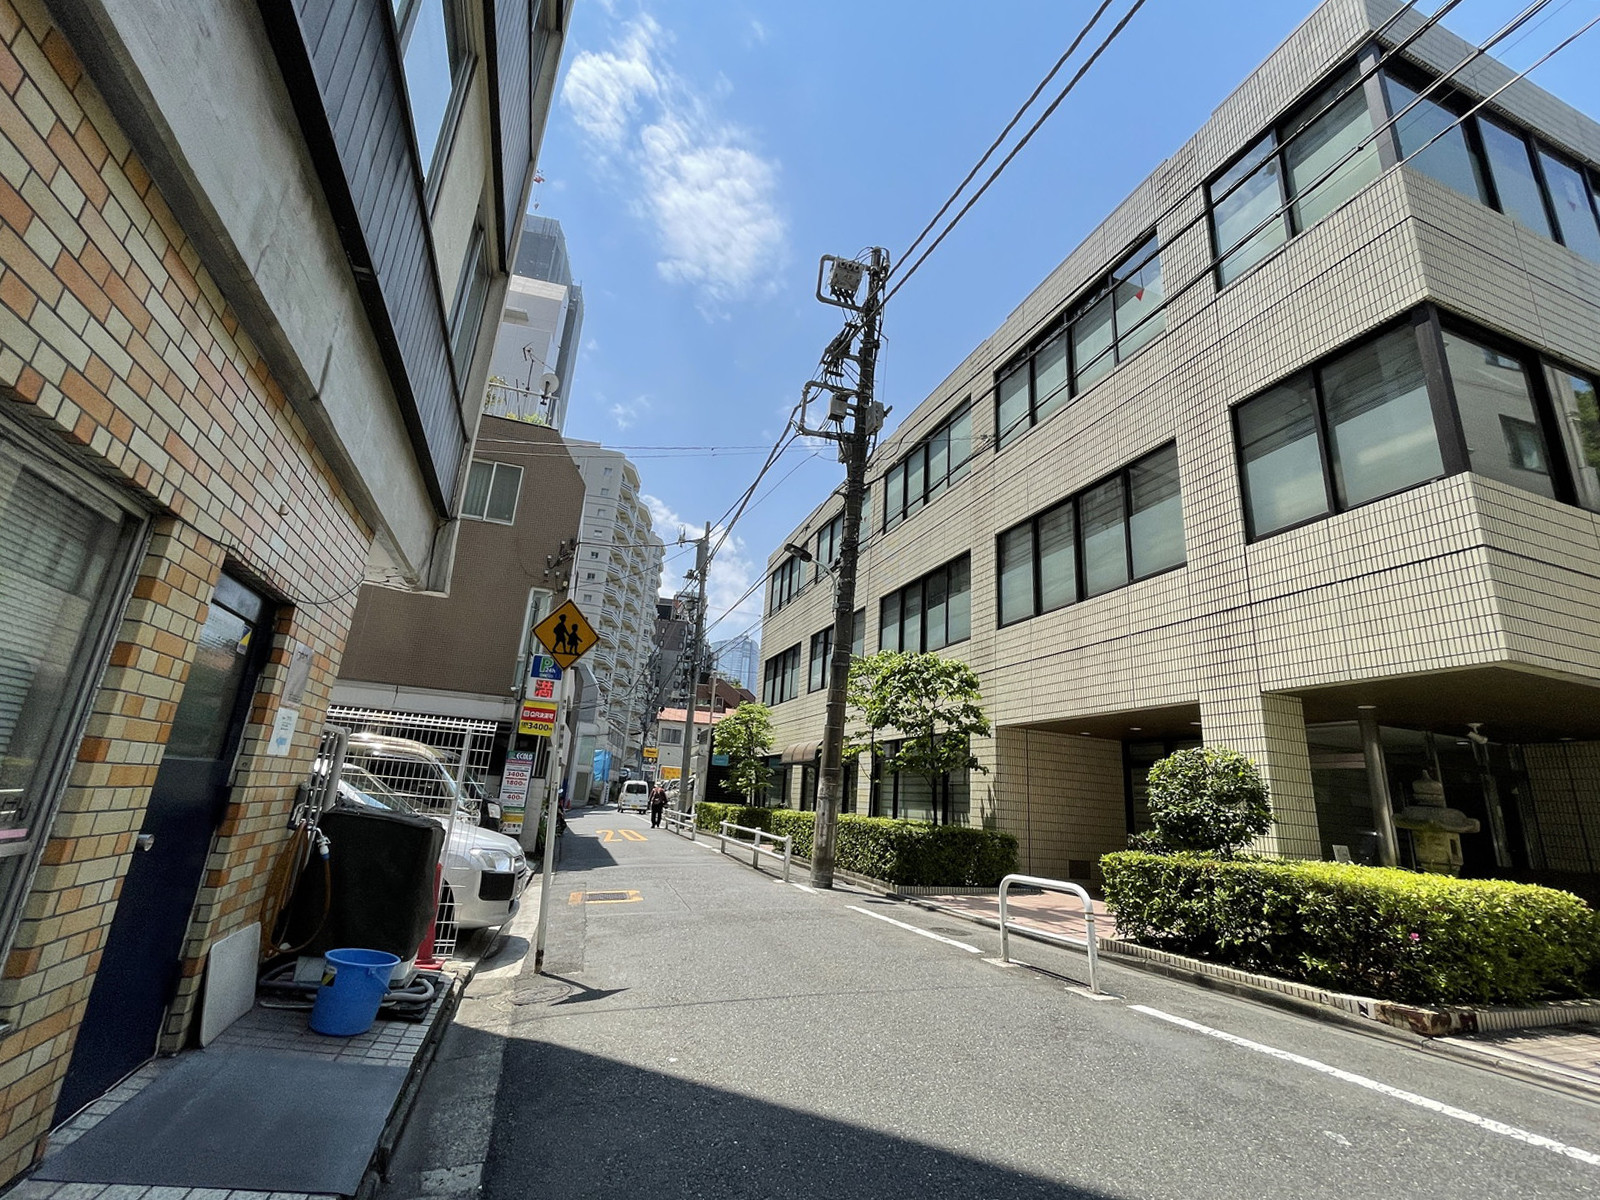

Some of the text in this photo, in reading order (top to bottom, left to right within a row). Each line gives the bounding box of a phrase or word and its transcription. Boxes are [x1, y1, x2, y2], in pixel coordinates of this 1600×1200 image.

[540, 656, 554, 673] P
[535, 679, 554, 698] 満
[595, 829, 649, 843] 20
